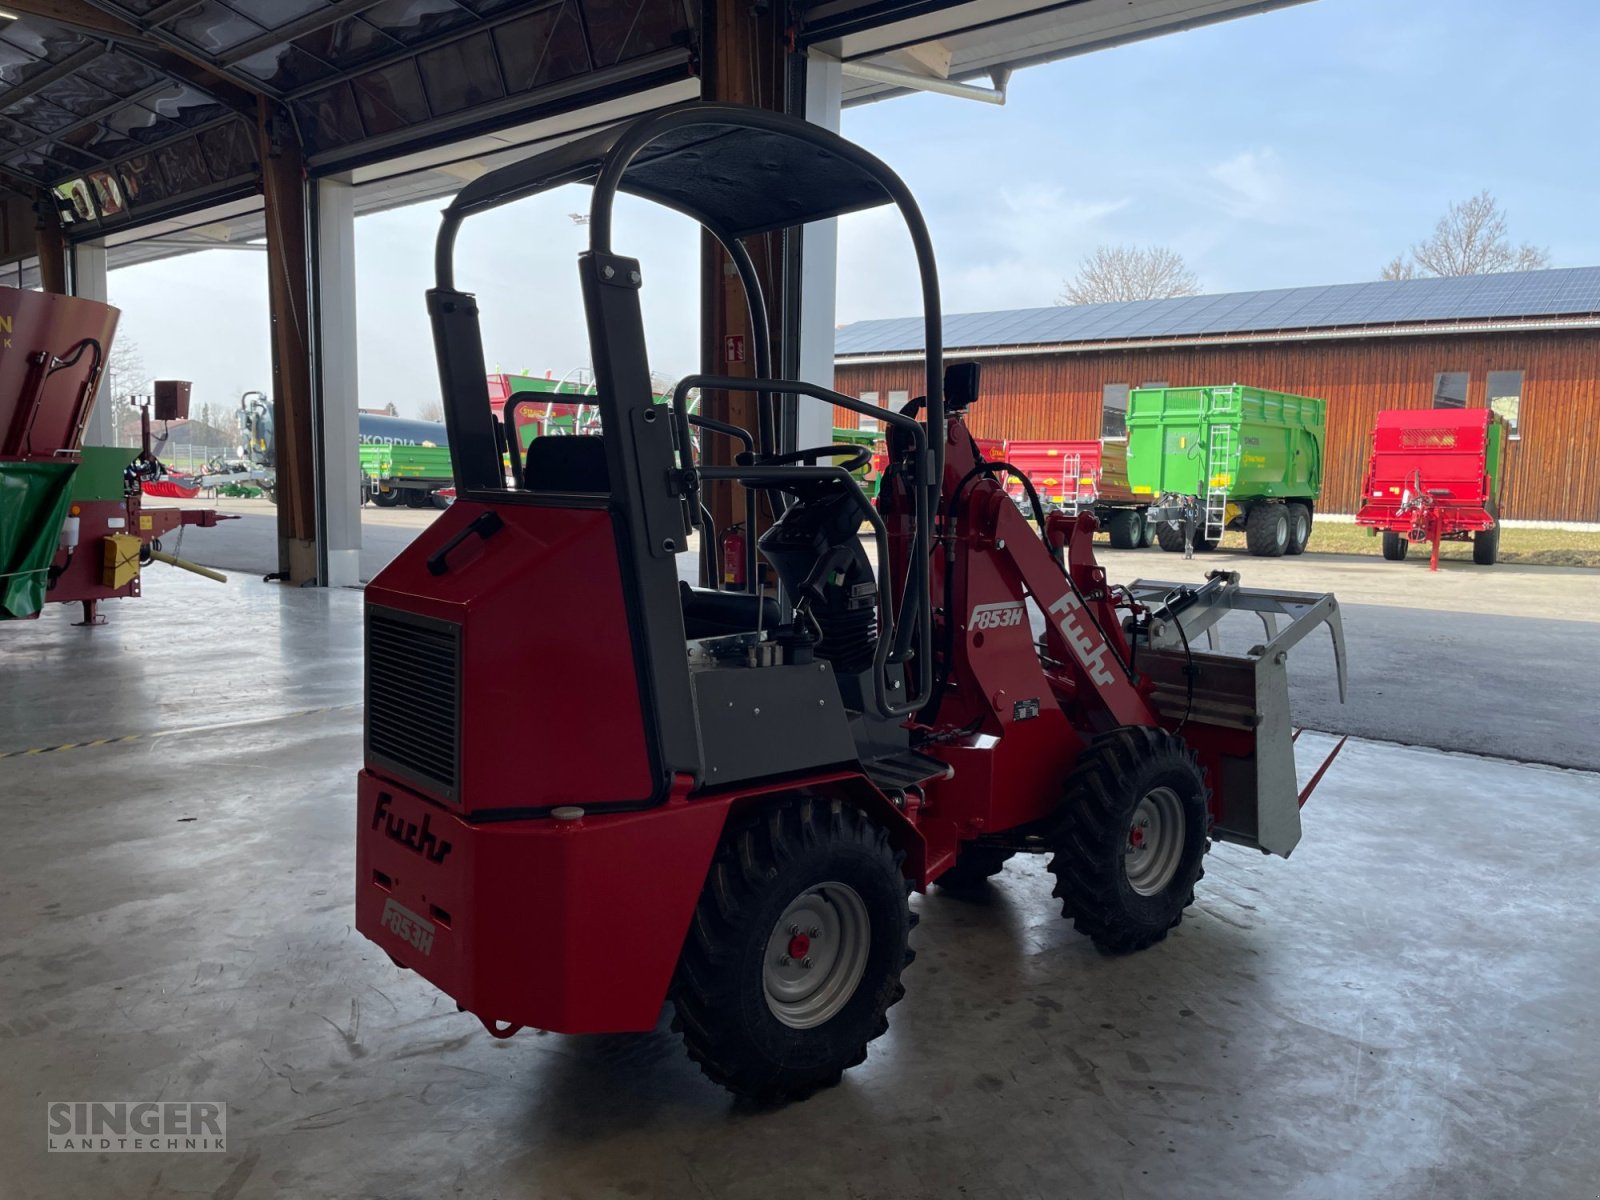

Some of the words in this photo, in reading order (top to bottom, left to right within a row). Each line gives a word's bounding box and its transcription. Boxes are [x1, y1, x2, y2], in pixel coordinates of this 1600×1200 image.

[967, 600, 1025, 631] F853H
[1048, 591, 1114, 686] Fuchs
[372, 792, 452, 865] Fuchs
[381, 898, 436, 956] F853H
